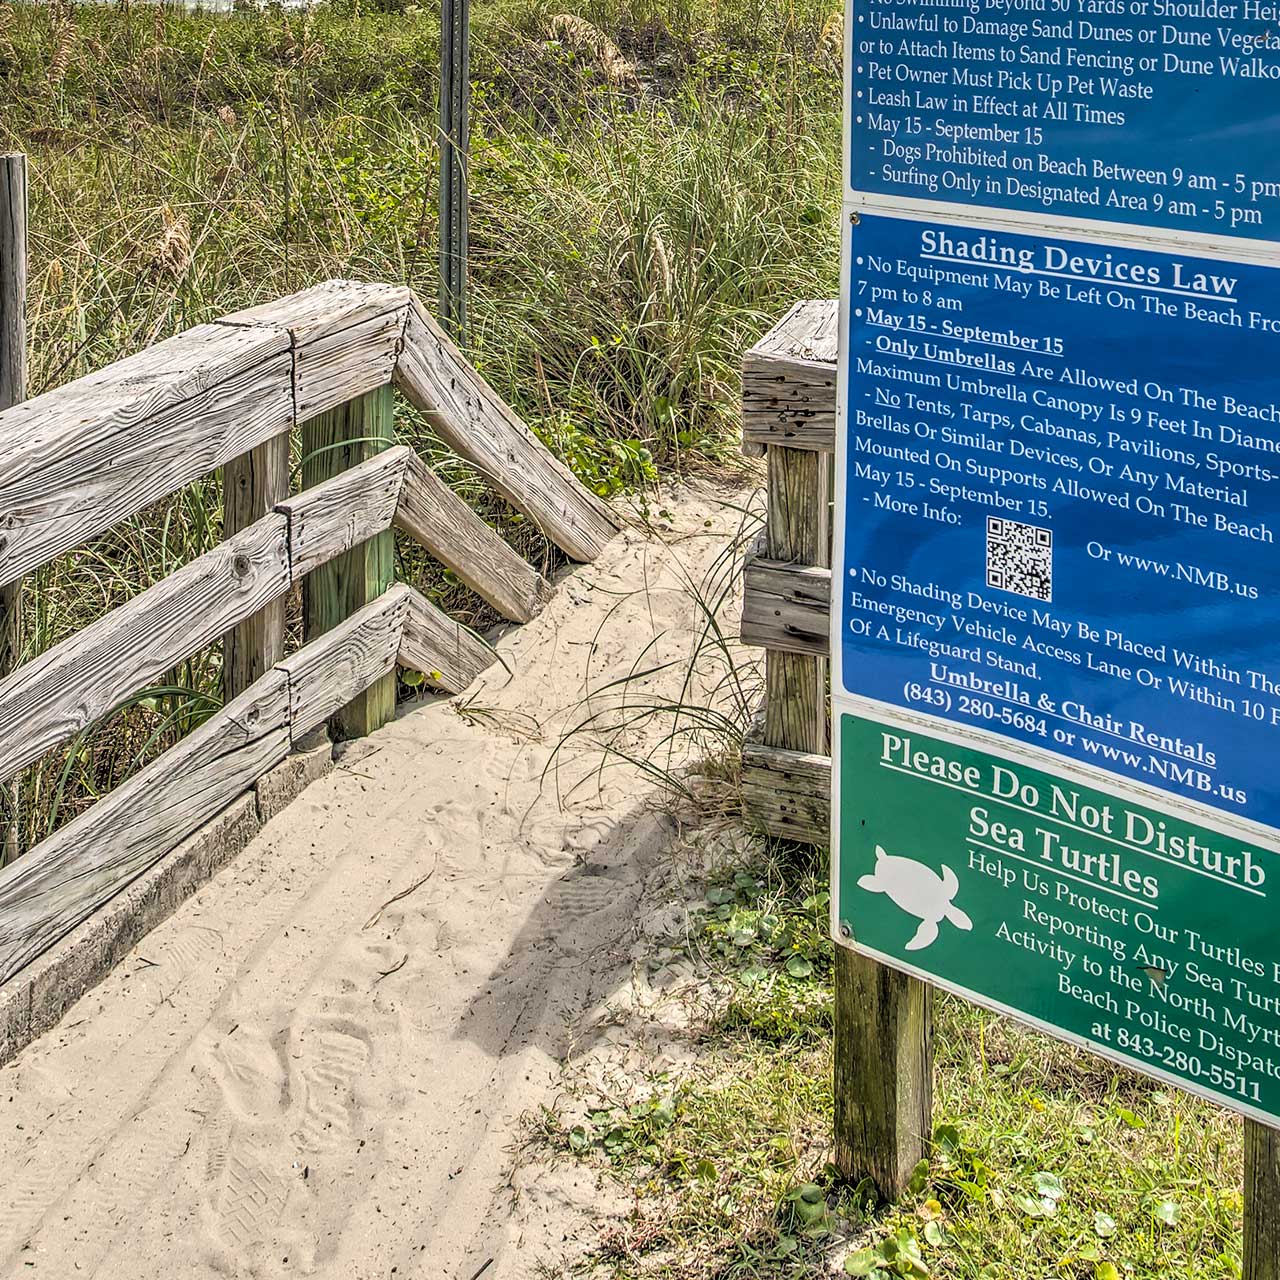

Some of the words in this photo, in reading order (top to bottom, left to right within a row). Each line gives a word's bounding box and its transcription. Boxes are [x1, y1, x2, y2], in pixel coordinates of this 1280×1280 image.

[870, 11, 938, 31] Unlawful
[943, 17, 958, 32] to
[963, 15, 1028, 42] Damage
[1032, 18, 1072, 39] Sand
[1078, 20, 1133, 42] Dunes
[1138, 29, 1156, 43] or
[1162, 24, 1211, 46] Dune
[1130, 1, 1149, 15] or
[859, 40, 875, 53] or
[879, 39, 893, 54] to
[897, 39, 947, 58] Attach
[952, 41, 995, 61] Items
[1000, 46, 1015, 62] to
[1020, 44, 1060, 65] Sand
[1066, 47, 1134, 76] Fencing
[1139, 57, 1158, 71] or
[1163, 52, 1213, 74] Dune
[868, 61, 891, 80] Pet
[895, 63, 948, 84] Owner
[952, 67, 993, 87] Must
[997, 70, 1032, 90] Pick
[1037, 73, 1062, 98] Up
[1067, 75, 1094, 95] Pet
[1099, 77, 1153, 99] Waste
[869, 87, 910, 107] Leash
[915, 90, 948, 110] Law
[953, 94, 967, 112] in
[973, 95, 1018, 116] Effect
[1022, 102, 1037, 118] at
[1042, 101, 1067, 120] All
[1072, 103, 1124, 125] Times
[858, 280, 867, 295] 7
[871, 286, 897, 302] pm
[902, 288, 918, 303] to
[922, 290, 932, 305] 8
[936, 296, 962, 311] am
[867, 255, 891, 273] No
[896, 259, 988, 288] Equipment
[994, 273, 1032, 298] May
[1039, 280, 1060, 298] Be
[1066, 283, 1101, 304] Left
[1106, 290, 1135, 310] On
[1141, 295, 1177, 316] The
[1183, 301, 1242, 327] Beach
[920, 229, 1035, 273] Shading
[1044, 245, 1160, 284] Devices
[1172, 263, 1237, 295] Law
[857, 357, 940, 387] Maximum
[946, 373, 1027, 403] Umbrella
[1032, 389, 1103, 422] Canopy
[1110, 403, 1125, 421] Is
[1130, 407, 1141, 424] 9
[1147, 410, 1186, 434] Feet
[1192, 419, 1212, 439] In
[851, 591, 945, 631] Emergency
[951, 615, 1016, 645] Vehicle
[1021, 636, 1081, 664] Access
[1087, 653, 1131, 680] Lane
[1136, 668, 1162, 689] Or
[1167, 676, 1235, 712] Within
[1241, 699, 1264, 720] 10
[861, 567, 886, 586] No
[891, 574, 962, 610] Shading
[967, 592, 1027, 621] Device
[1032, 609, 1071, 638] May
[1077, 621, 1099, 642] Be
[1105, 629, 1165, 662] Placed
[1172, 648, 1240, 684] Within
[903, 681, 951, 712] (843)
[958, 695, 1047, 737] 280-5684
[1053, 729, 1075, 746] or
[1081, 737, 1246, 804] www.NMB.us
[930, 663, 1030, 704] Umbrella
[1037, 693, 1056, 713] &
[1061, 700, 1123, 735] Chair
[1129, 721, 1216, 765] Rentals
[880, 732, 980, 788] Please
[991, 764, 1039, 807] Do
[1049, 784, 1113, 834] Not
[1124, 809, 1265, 884] Disturb
[969, 806, 1025, 851] Sea
[1035, 827, 1158, 898] Turtles
[967, 849, 1016, 888] Help
[1022, 868, 1048, 895] Us
[1055, 881, 1128, 925] Protect
[1134, 912, 1178, 943] Our
[1184, 929, 1264, 976] Turtles
[1023, 899, 1126, 961] Reporting
[1132, 943, 1179, 979] Any
[1185, 962, 1223, 993] Sea
[995, 921, 1075, 970] Activity
[1082, 955, 1102, 976] to
[1109, 965, 1142, 992] the
[1148, 977, 1216, 1022] North
[1058, 972, 1118, 1014] Beach
[1125, 999, 1190, 1042] Police
[1091, 1022, 1111, 1040] at
[1117, 1027, 1261, 1102] 843-280-5511
